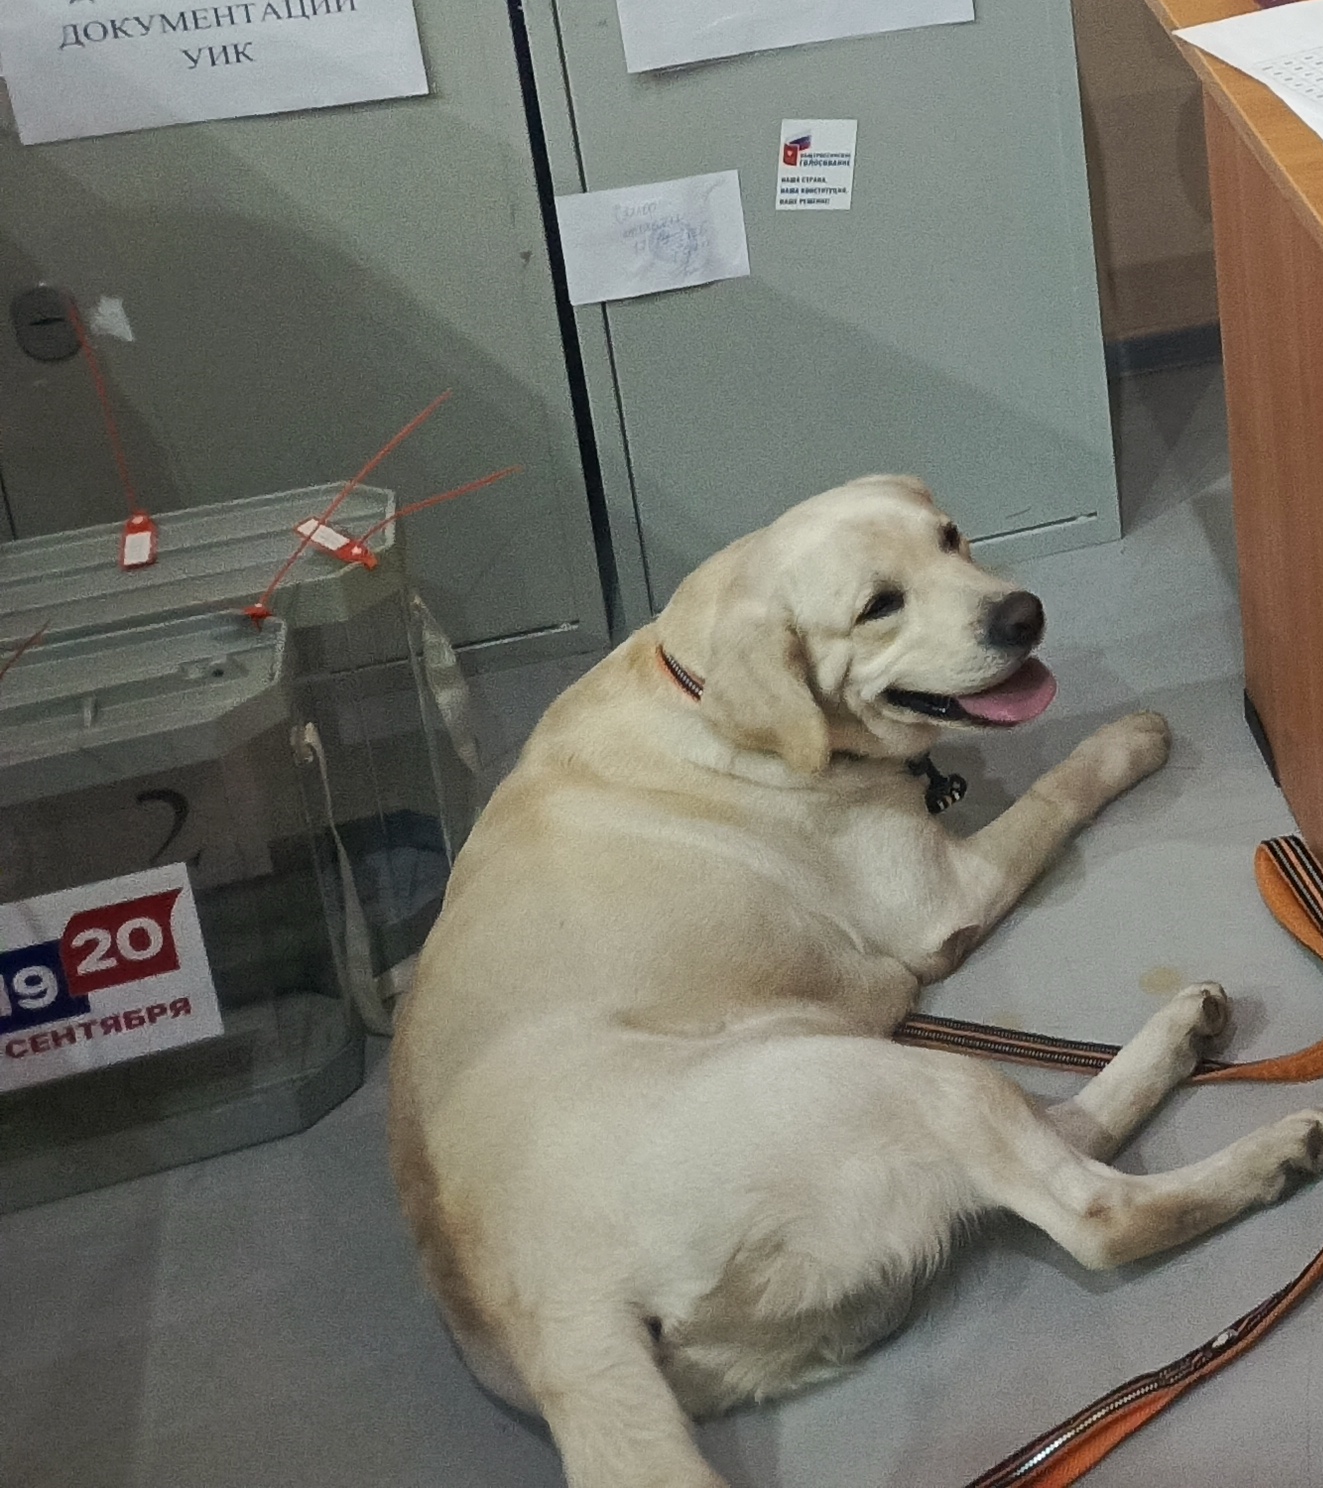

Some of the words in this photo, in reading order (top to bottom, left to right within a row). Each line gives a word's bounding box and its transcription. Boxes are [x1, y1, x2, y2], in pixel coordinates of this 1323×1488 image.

[181, 42, 254, 69] УИК
[70, 916, 164, 976] 20
[4, 996, 192, 1059] СЕНТЯБРЯ
